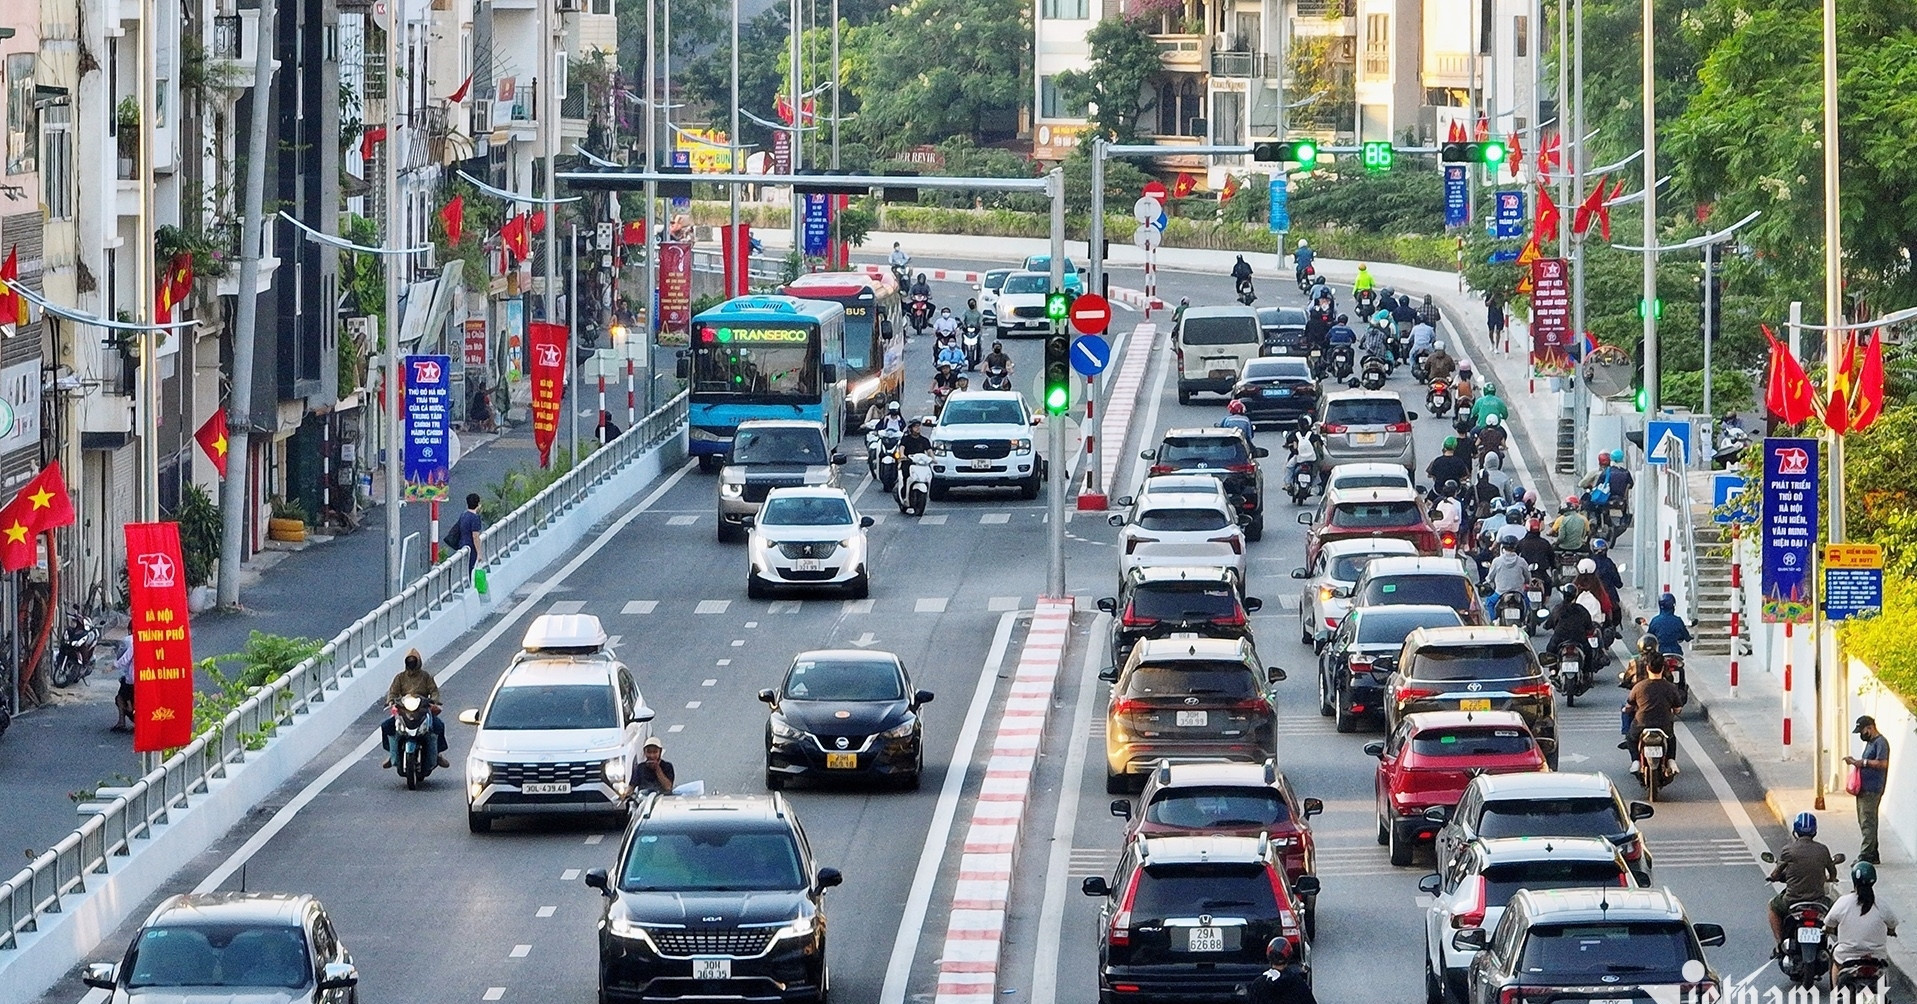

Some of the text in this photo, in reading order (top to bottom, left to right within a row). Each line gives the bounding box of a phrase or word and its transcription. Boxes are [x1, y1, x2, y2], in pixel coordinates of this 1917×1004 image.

[1366, 143, 1391, 165] 86
[846, 308, 866, 316] BUS
[732, 328, 807, 342] TRANSERCO
[1774, 447, 1810, 475] 70
[1771, 478, 1811, 490] PHÁT TRIỂN
[1778, 491, 1803, 501] THỦ ĐÔ
[1778, 503, 1803, 514] HÀ NỘI
[138, 552, 175, 588] 70
[157, 608, 174, 624] NỘI
[166, 625, 185, 641] PHỐ
[139, 667, 155, 681] HÒA
[1197, 929, 1214, 939] 29A
[1190, 940, 1222, 950] 626.88
